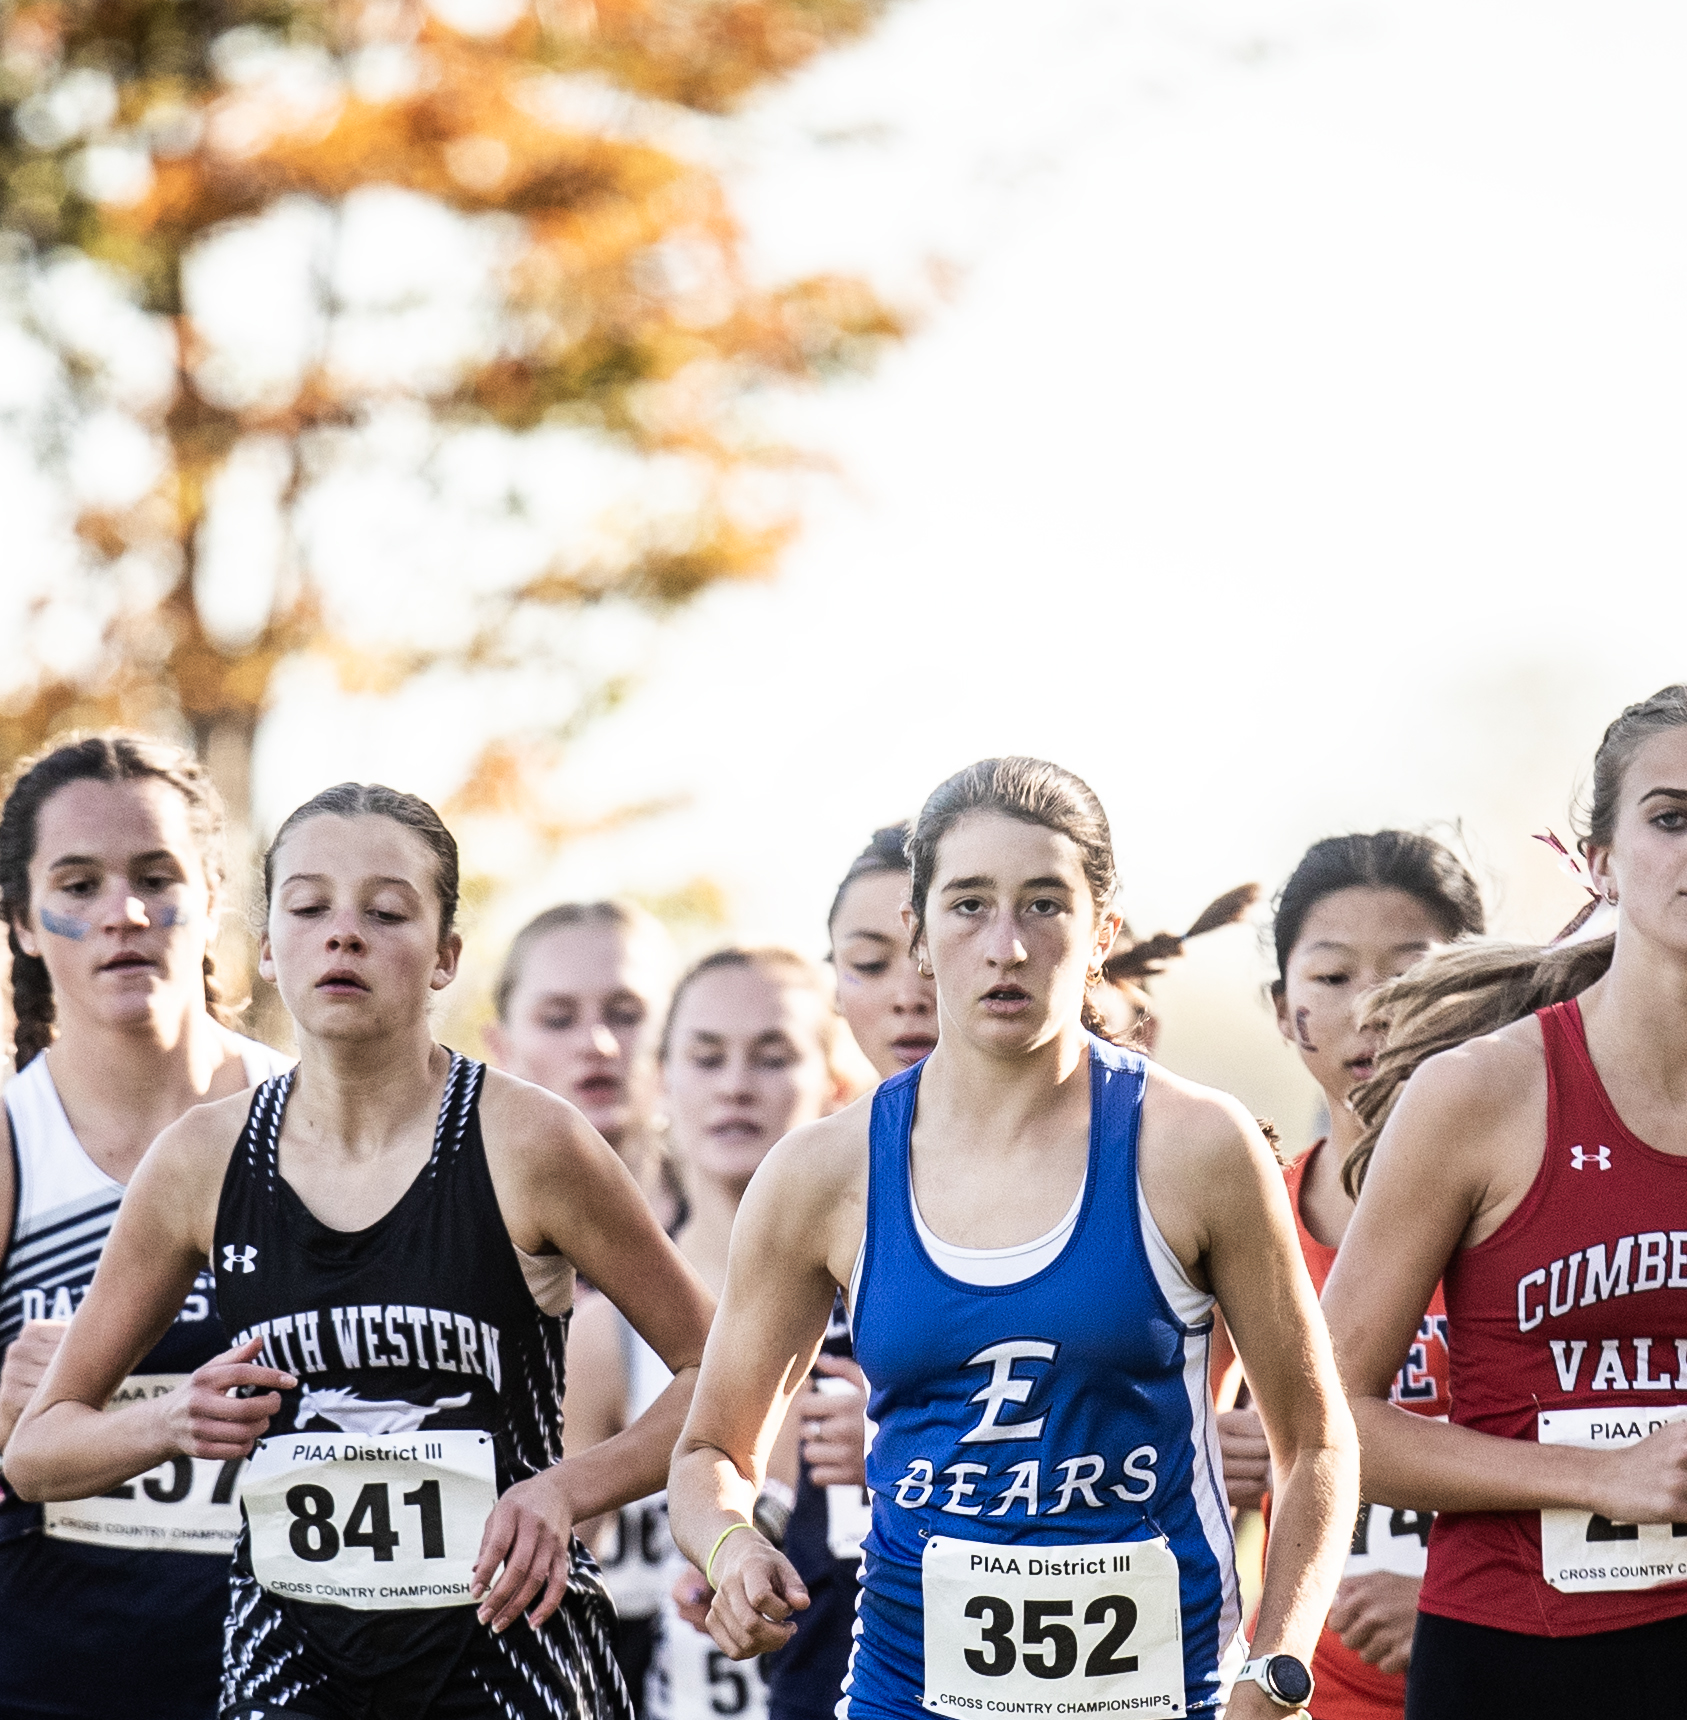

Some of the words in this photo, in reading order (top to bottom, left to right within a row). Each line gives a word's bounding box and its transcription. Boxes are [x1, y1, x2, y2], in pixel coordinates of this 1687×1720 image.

[231, 1310, 328, 1377] UTH
[330, 1304, 502, 1395] WESTERN
[956, 1335, 1062, 1445] E
[1591, 1420, 1643, 1441] PIAA
[292, 1445, 338, 1462] PIAA
[343, 1444, 418, 1462] District
[424, 1443, 443, 1460] III
[891, 1443, 1160, 1518] BEARS
[285, 1479, 446, 1563] 841
[969, 1554, 1022, 1576] PIAA
[1028, 1555, 1107, 1577] District
[1112, 1554, 1131, 1573] III
[1559, 1568, 1607, 1582] CROSS
[1610, 1562, 1676, 1579] COUNTRY
[271, 1580, 313, 1595] CROSS
[315, 1583, 376, 1599] COUNTRY
[379, 1583, 492, 1598] CHAMPIONSH
[962, 1594, 1139, 1680] 352
[939, 1693, 983, 1711] CROSS
[986, 1699, 1054, 1715] COUNTRY
[1056, 1695, 1172, 1715] CHAMPIONSHIPS
